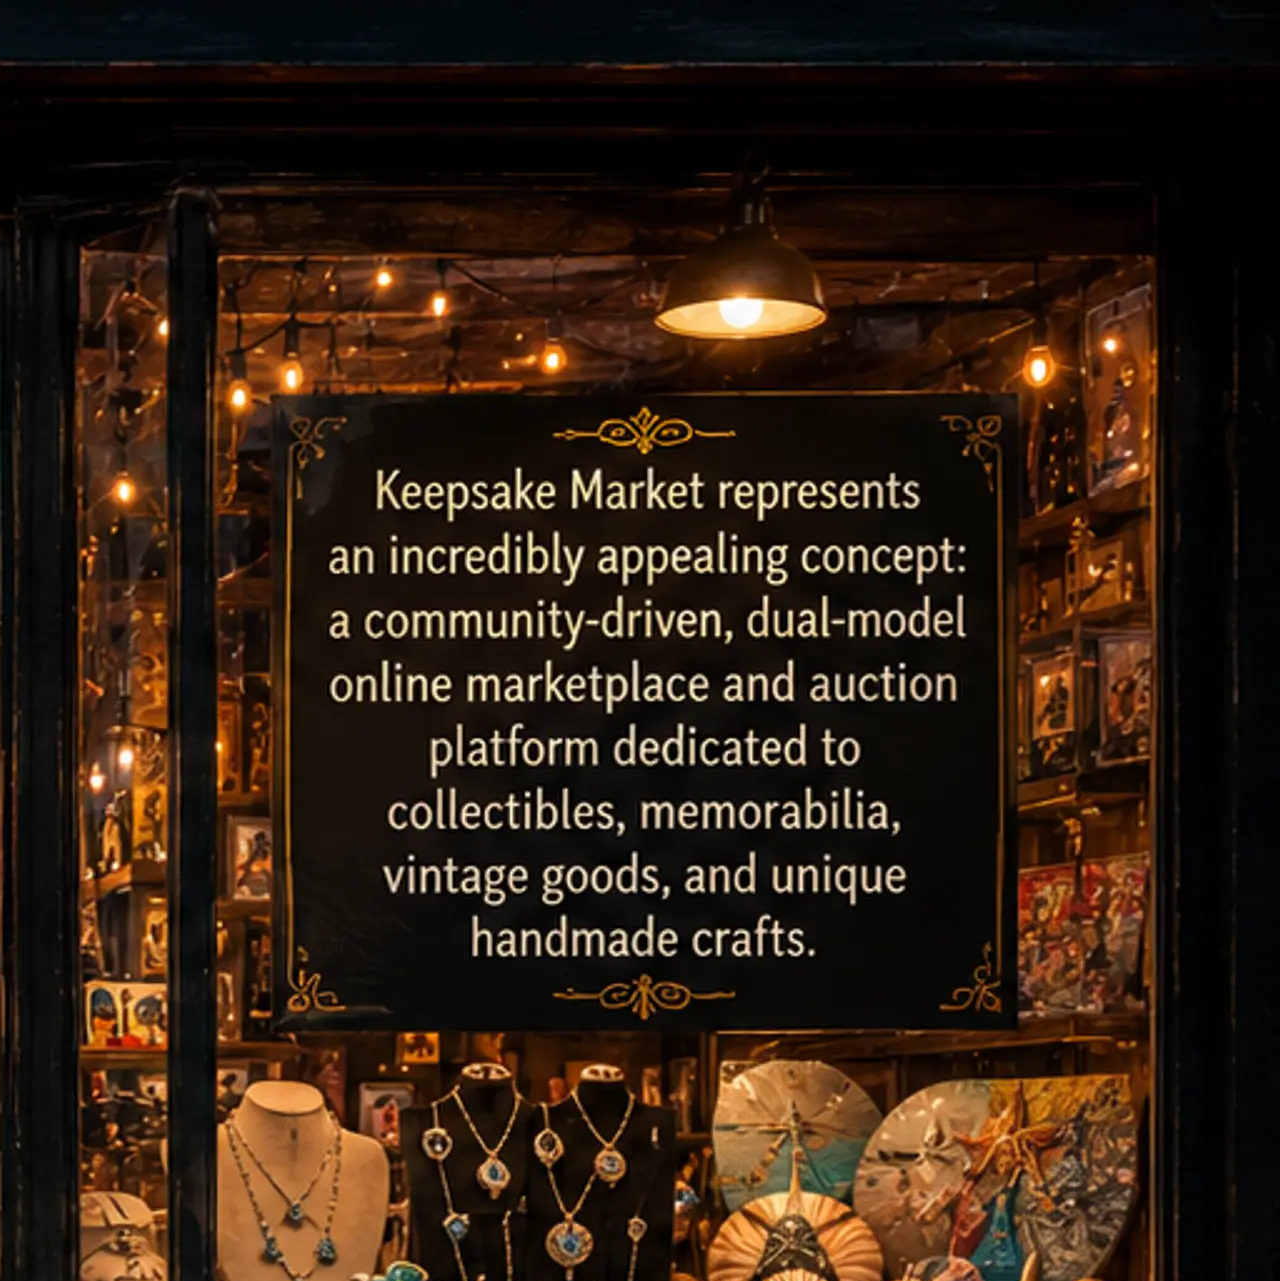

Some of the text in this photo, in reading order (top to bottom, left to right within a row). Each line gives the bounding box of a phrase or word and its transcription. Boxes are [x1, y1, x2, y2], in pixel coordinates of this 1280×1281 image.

[376, 466, 921, 521] Keepsake Market represents
[329, 530, 966, 586] an incredibly appealing concept:
[329, 594, 967, 650] a community-driven, dual-model
[329, 659, 957, 713] online marketplace and auction
[430, 722, 861, 778] platform dedicated to
[387, 786, 901, 835] collectibles, memorabilia,
[382, 851, 907, 905] vintage goods, and unique
[472, 914, 815, 957] handmade crafts.
